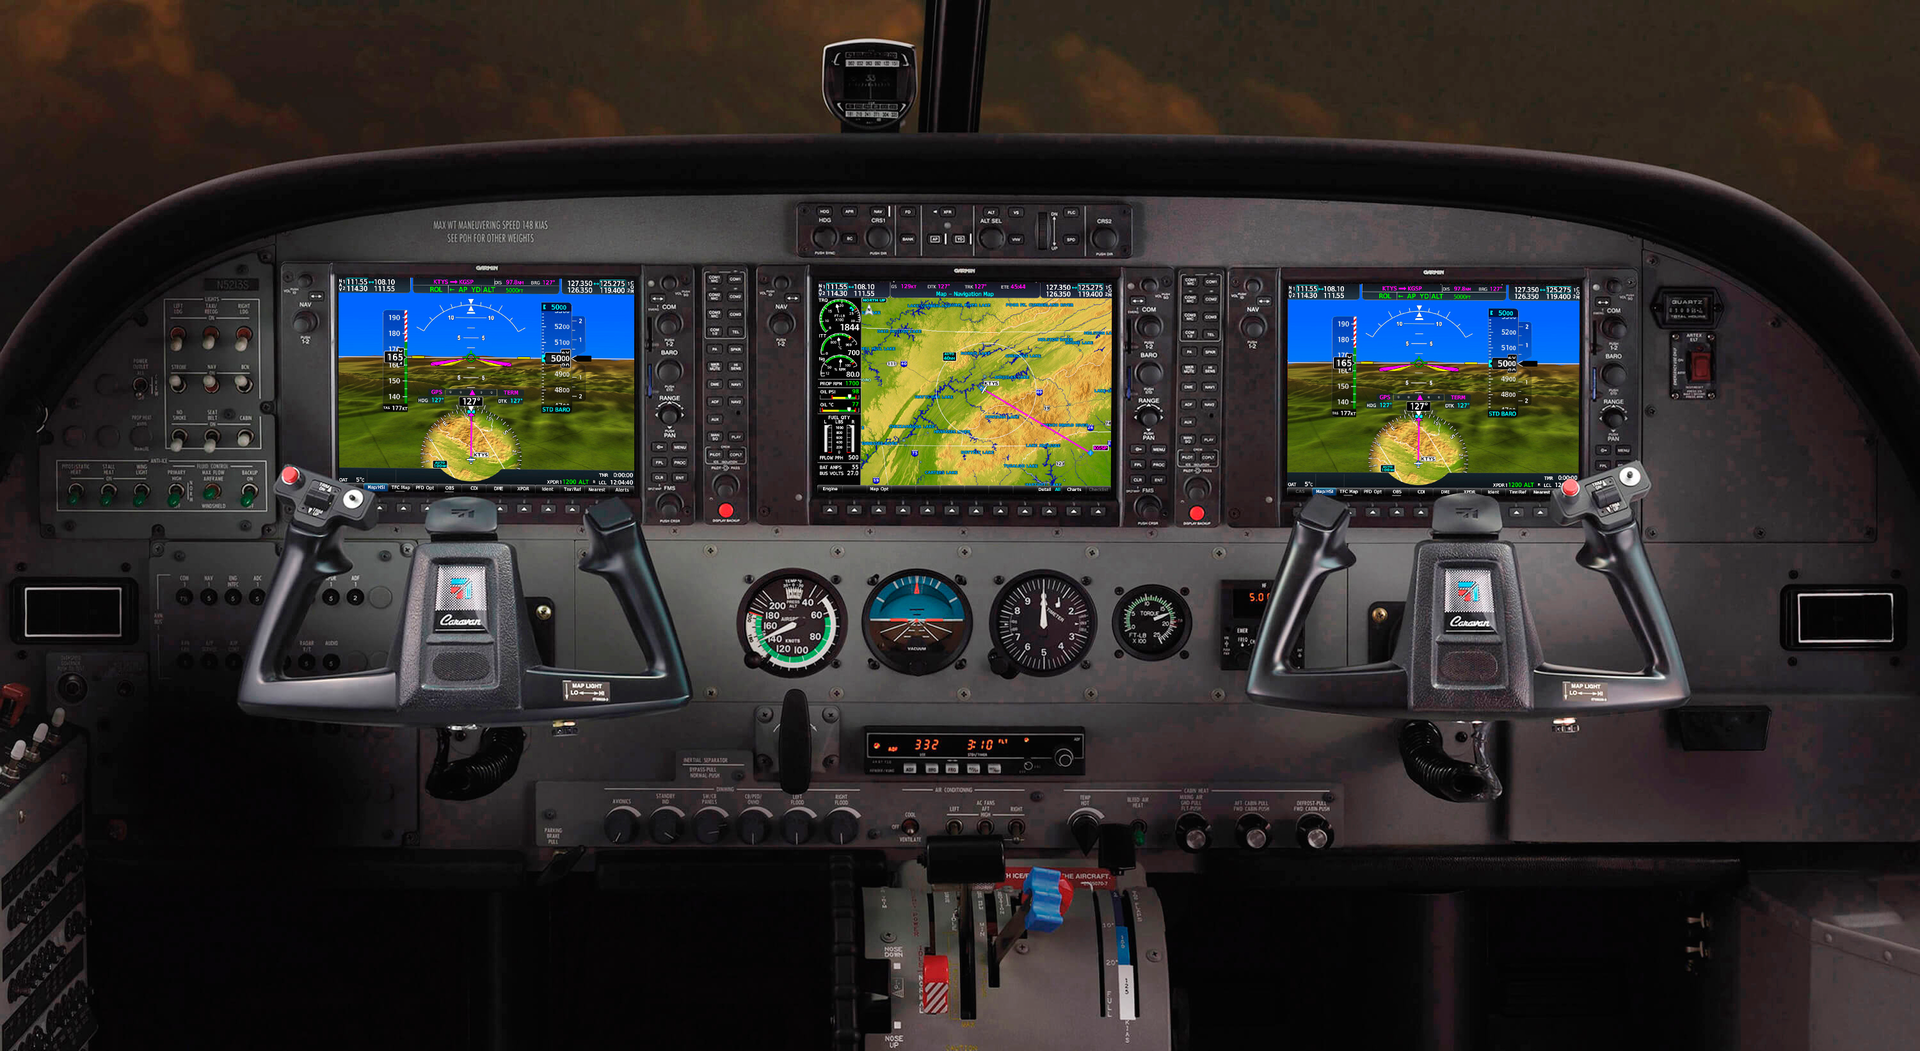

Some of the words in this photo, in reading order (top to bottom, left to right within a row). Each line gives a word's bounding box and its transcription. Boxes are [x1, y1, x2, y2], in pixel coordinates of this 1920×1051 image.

[433, 220, 446, 229] MAX
[448, 220, 457, 229] WT
[458, 220, 500, 229] MANEUVERING
[502, 220, 520, 229] SPEED
[522, 220, 533, 229] 148
[535, 220, 548, 229] KIAS
[447, 234, 458, 243] SEE
[460, 234, 472, 243] POH
[474, 234, 485, 243] FOR
[487, 234, 506, 243] OTHER
[508, 234, 534, 243] WEIGHTS
[440, 614, 481, 625] Caravan
[1450, 616, 1490, 626] Caravan
[915, 739, 939, 750] 332
[967, 739, 993, 750] 3:10
